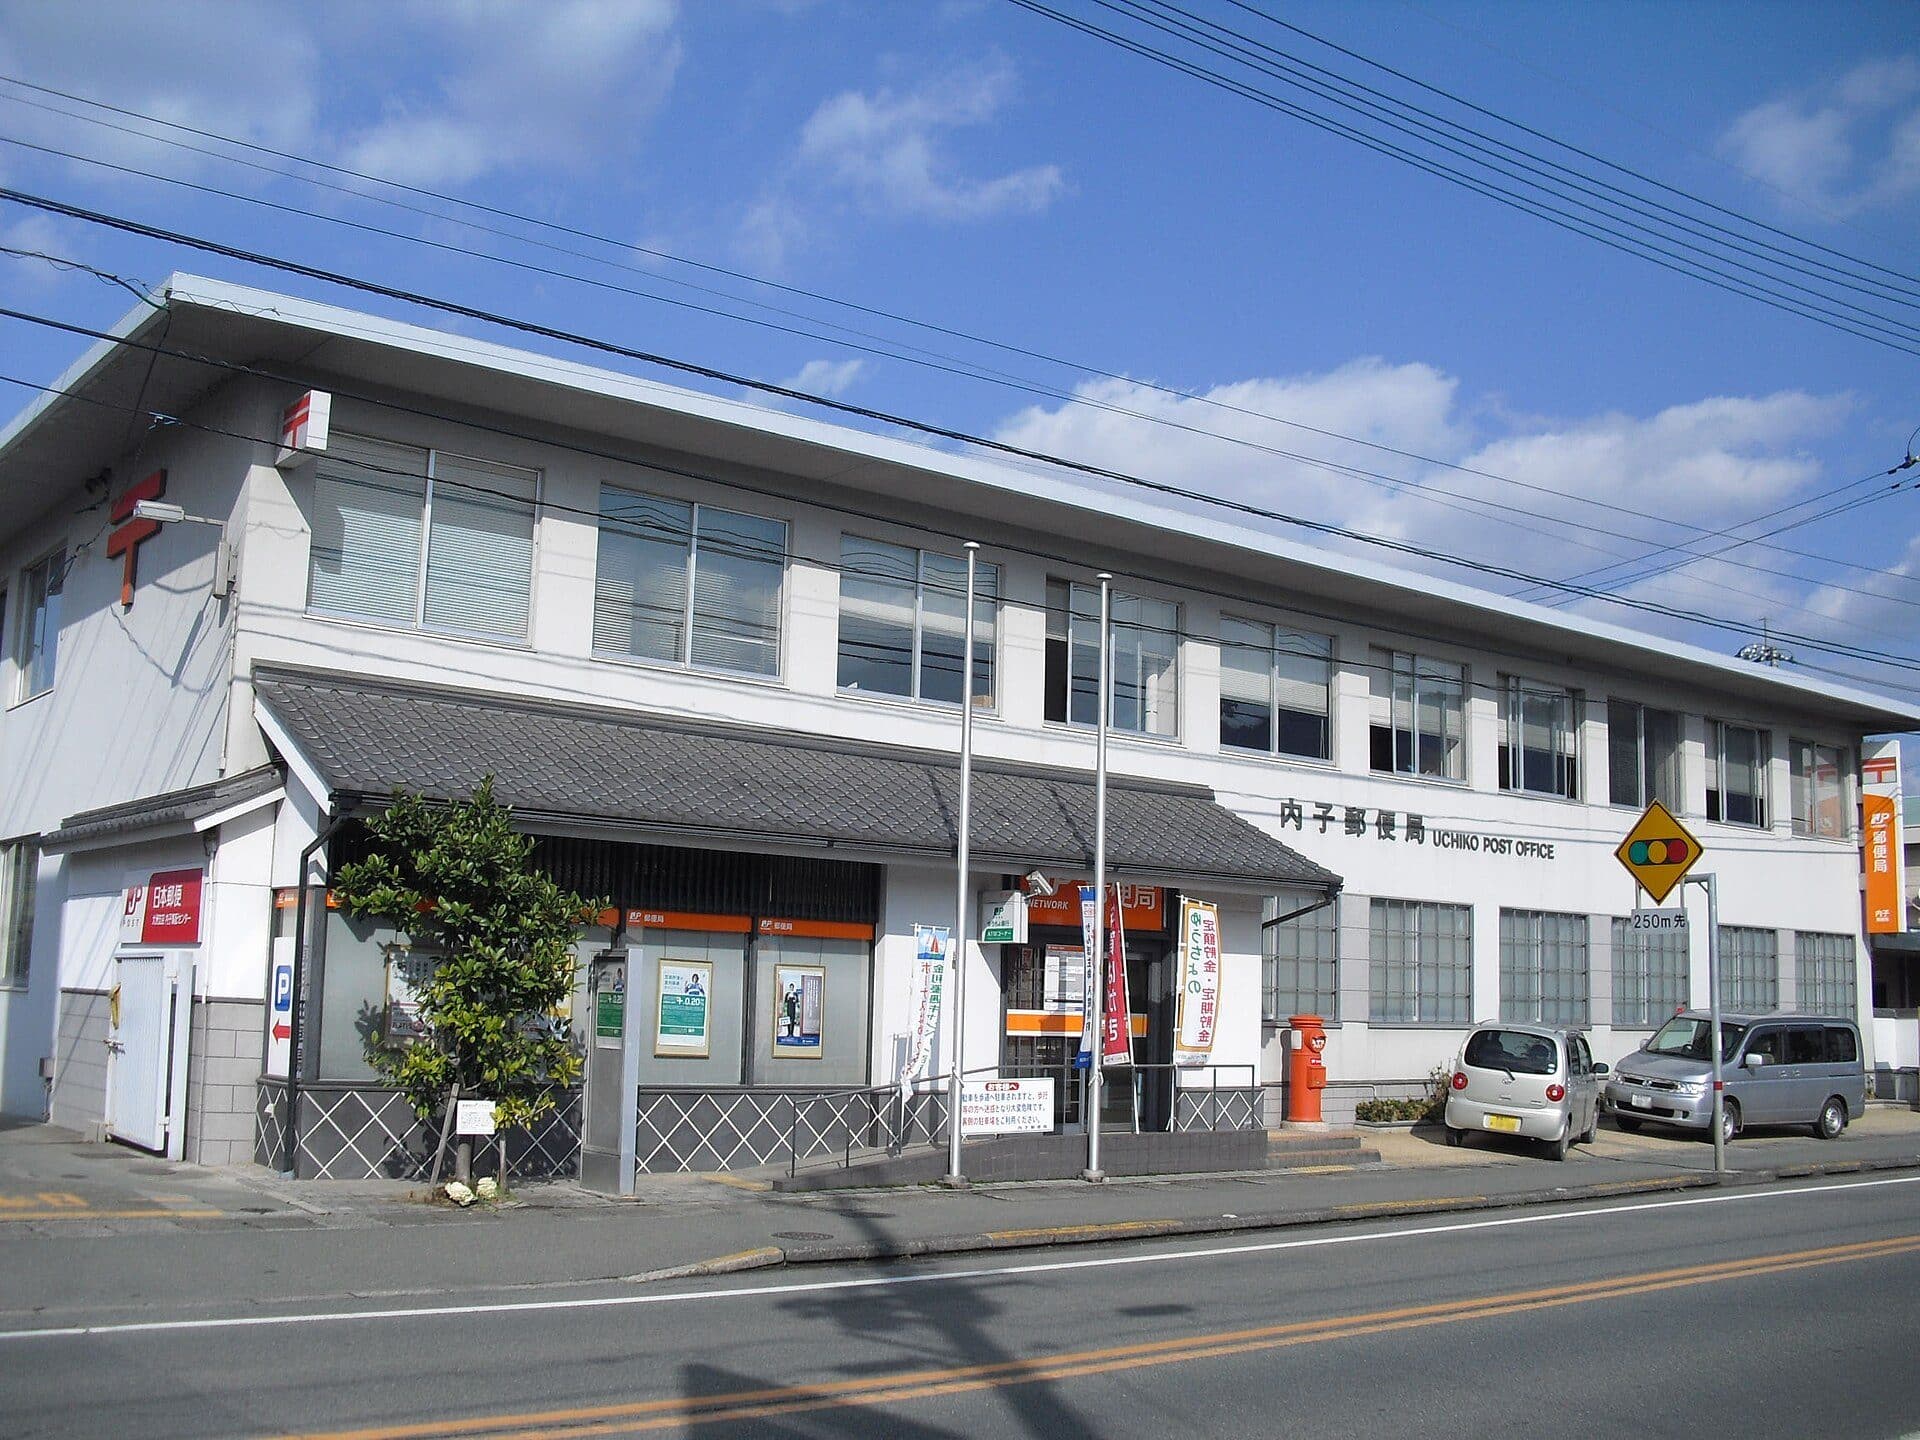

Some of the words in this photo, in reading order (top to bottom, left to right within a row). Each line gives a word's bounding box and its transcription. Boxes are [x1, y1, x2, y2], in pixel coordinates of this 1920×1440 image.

[1280, 798, 1425, 845] 内子郵便局
[1433, 830, 1480, 852] UCHIKO
[1483, 836, 1513, 856] POST
[1515, 840, 1555, 860] OFFICE
[1873, 831, 1887, 873] 郵便局
[153, 885, 184, 909] 日本郵便
[1633, 914, 1686, 929] 250m先
